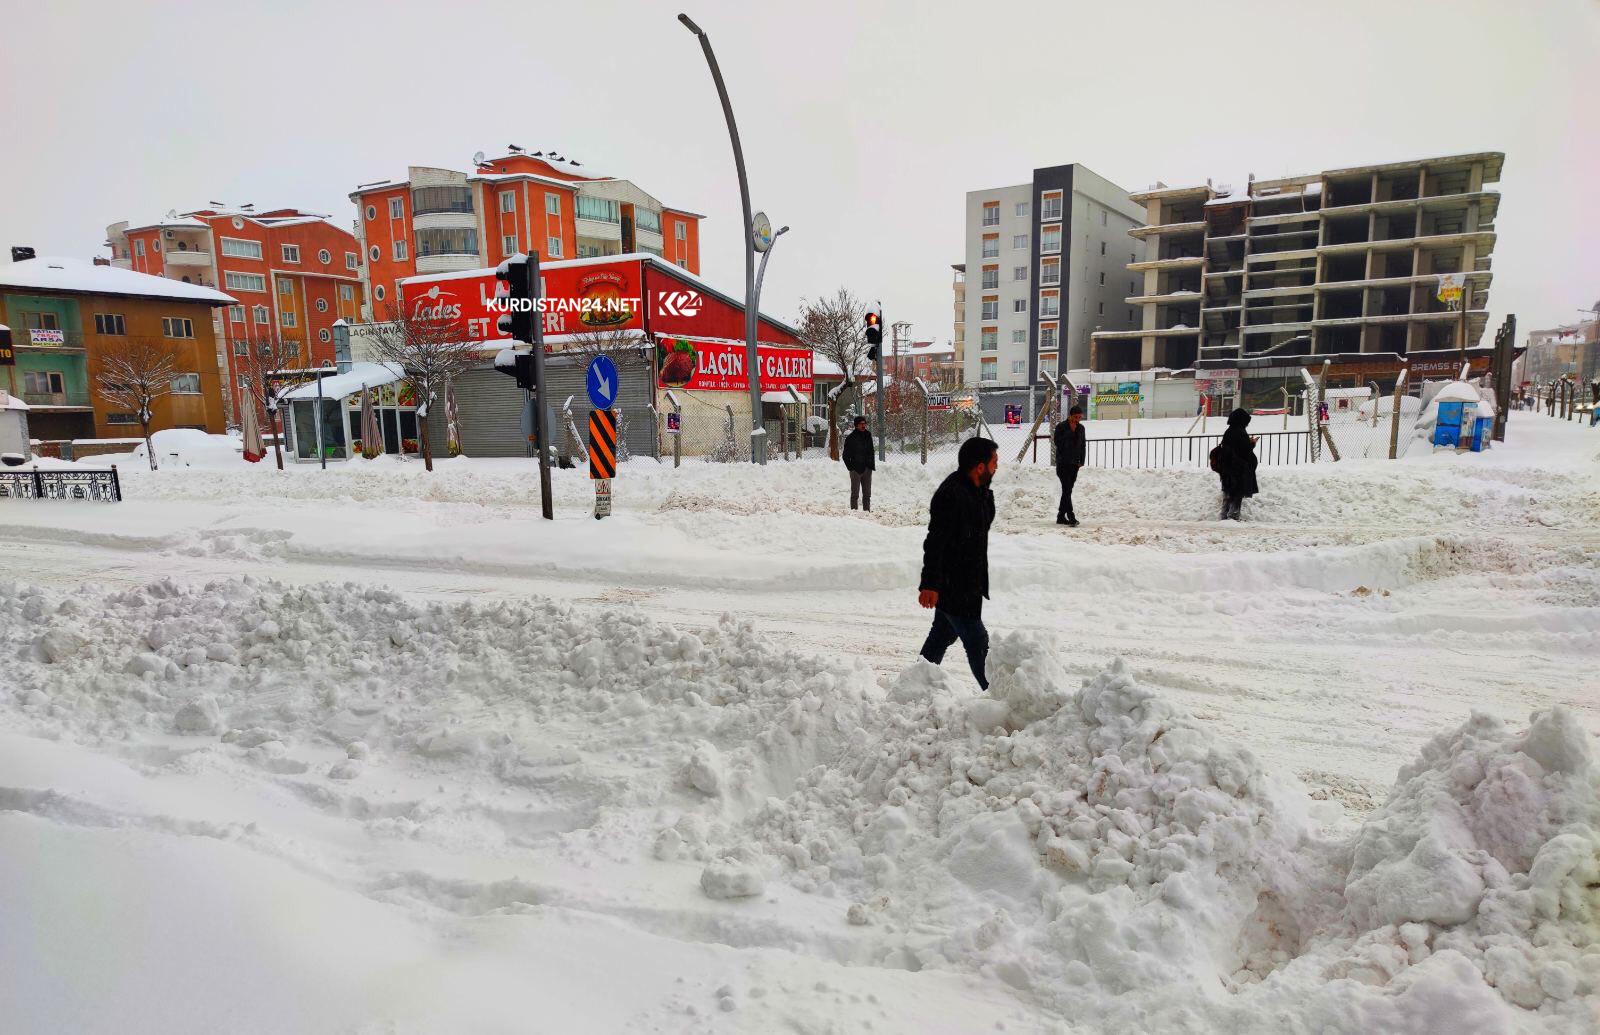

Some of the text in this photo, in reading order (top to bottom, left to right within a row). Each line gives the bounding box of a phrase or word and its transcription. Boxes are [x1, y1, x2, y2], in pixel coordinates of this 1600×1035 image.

[411, 298, 462, 321] Lades
[467, 317, 491, 338] ET
[698, 347, 742, 380] LAÇİN
[766, 352, 812, 378] GALERİ
